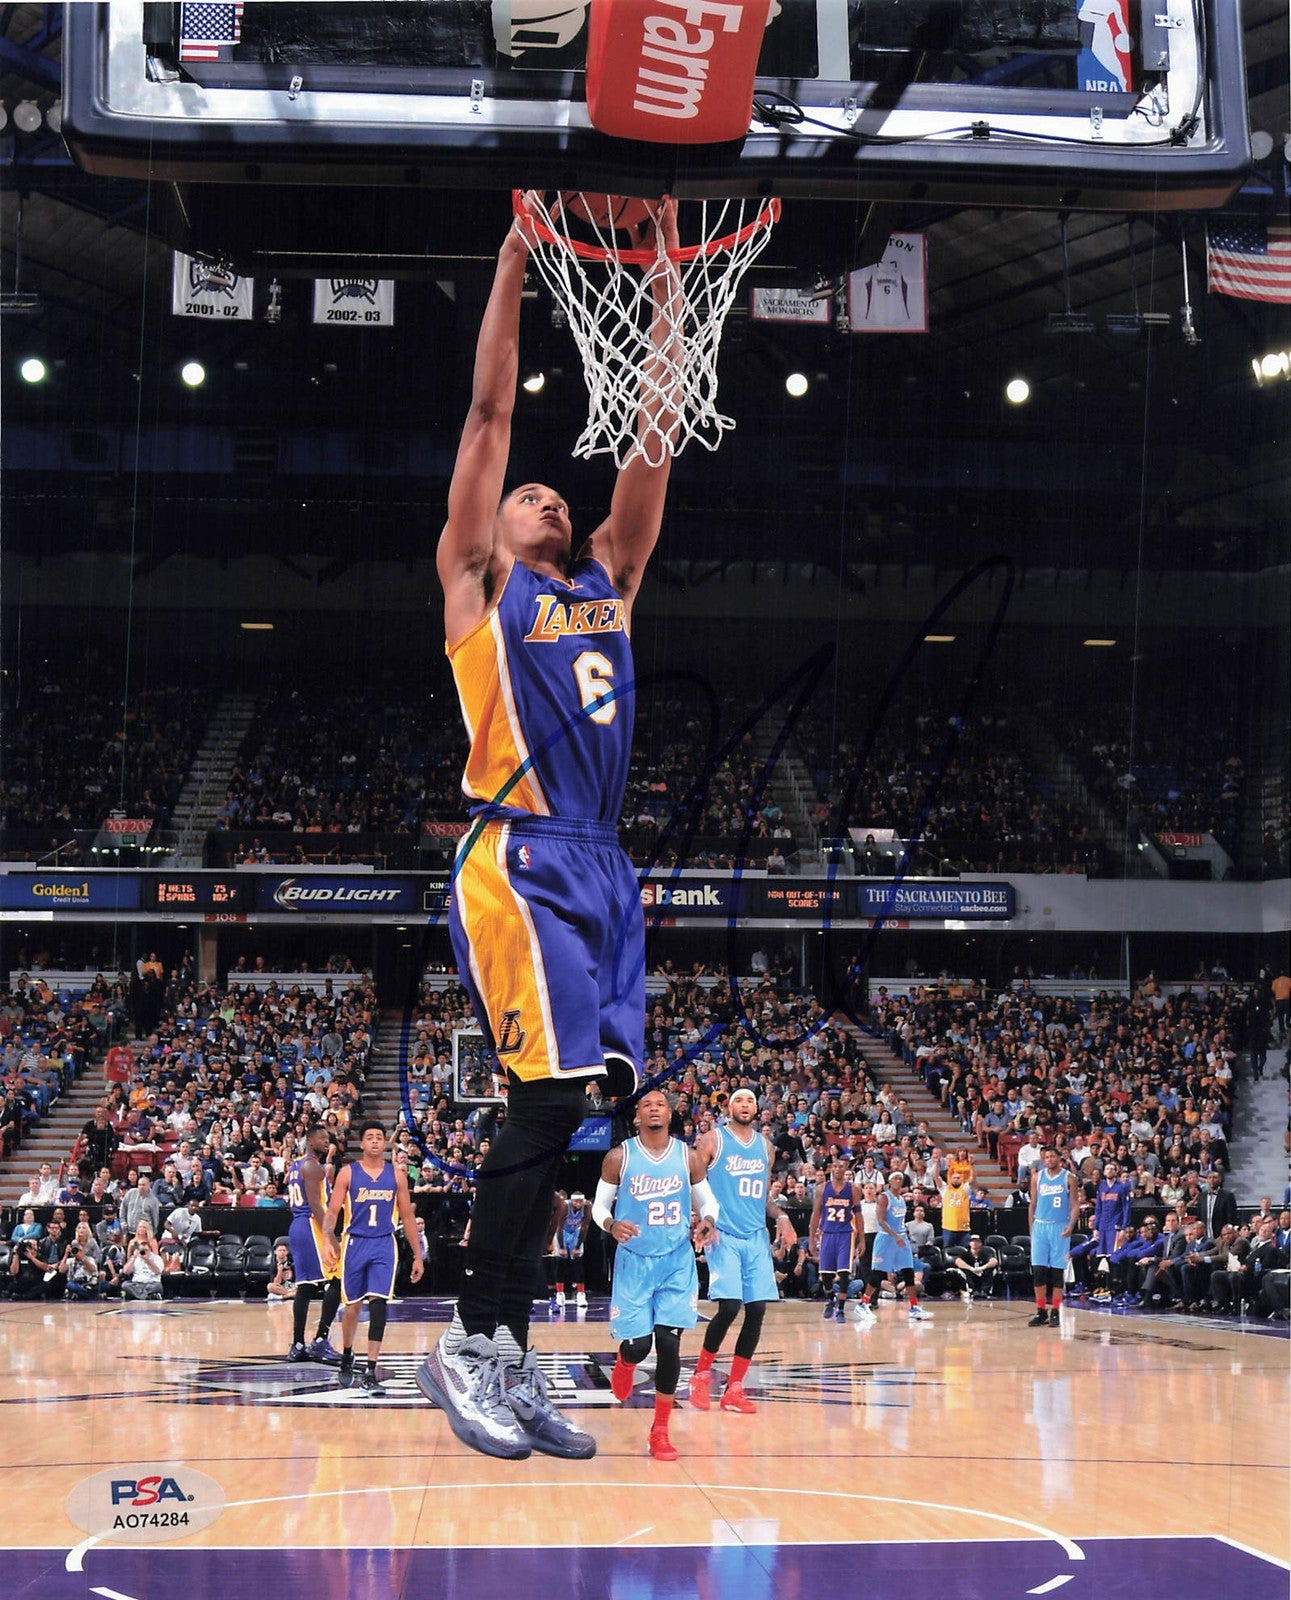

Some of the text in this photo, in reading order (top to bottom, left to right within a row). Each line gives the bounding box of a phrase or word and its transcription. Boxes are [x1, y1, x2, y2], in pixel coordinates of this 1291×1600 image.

[633, 0, 743, 119] Farm
[185, 303, 239, 317] 2001-02
[762, 299, 819, 309] SACRAMENTO
[767, 306, 814, 316] MONARCHS
[326, 309, 381, 322] 2002-03
[573, 652, 617, 725] 6
[284, 887, 401, 900] BUD LIGHT
[895, 889, 980, 902] SACRAMENTO
[983, 890, 1007, 903] BEE
[895, 904, 1007, 912] Stay Connected sacbee.com
[725, 1155, 765, 1176] Kings
[630, 1174, 683, 1201] Kings
[739, 1178, 763, 1198] 00
[1053, 1197, 1061, 1207] 8
[368, 1205, 378, 1226] 1
[648, 1201, 680, 1225] 23
[827, 1208, 845, 1222] 24
